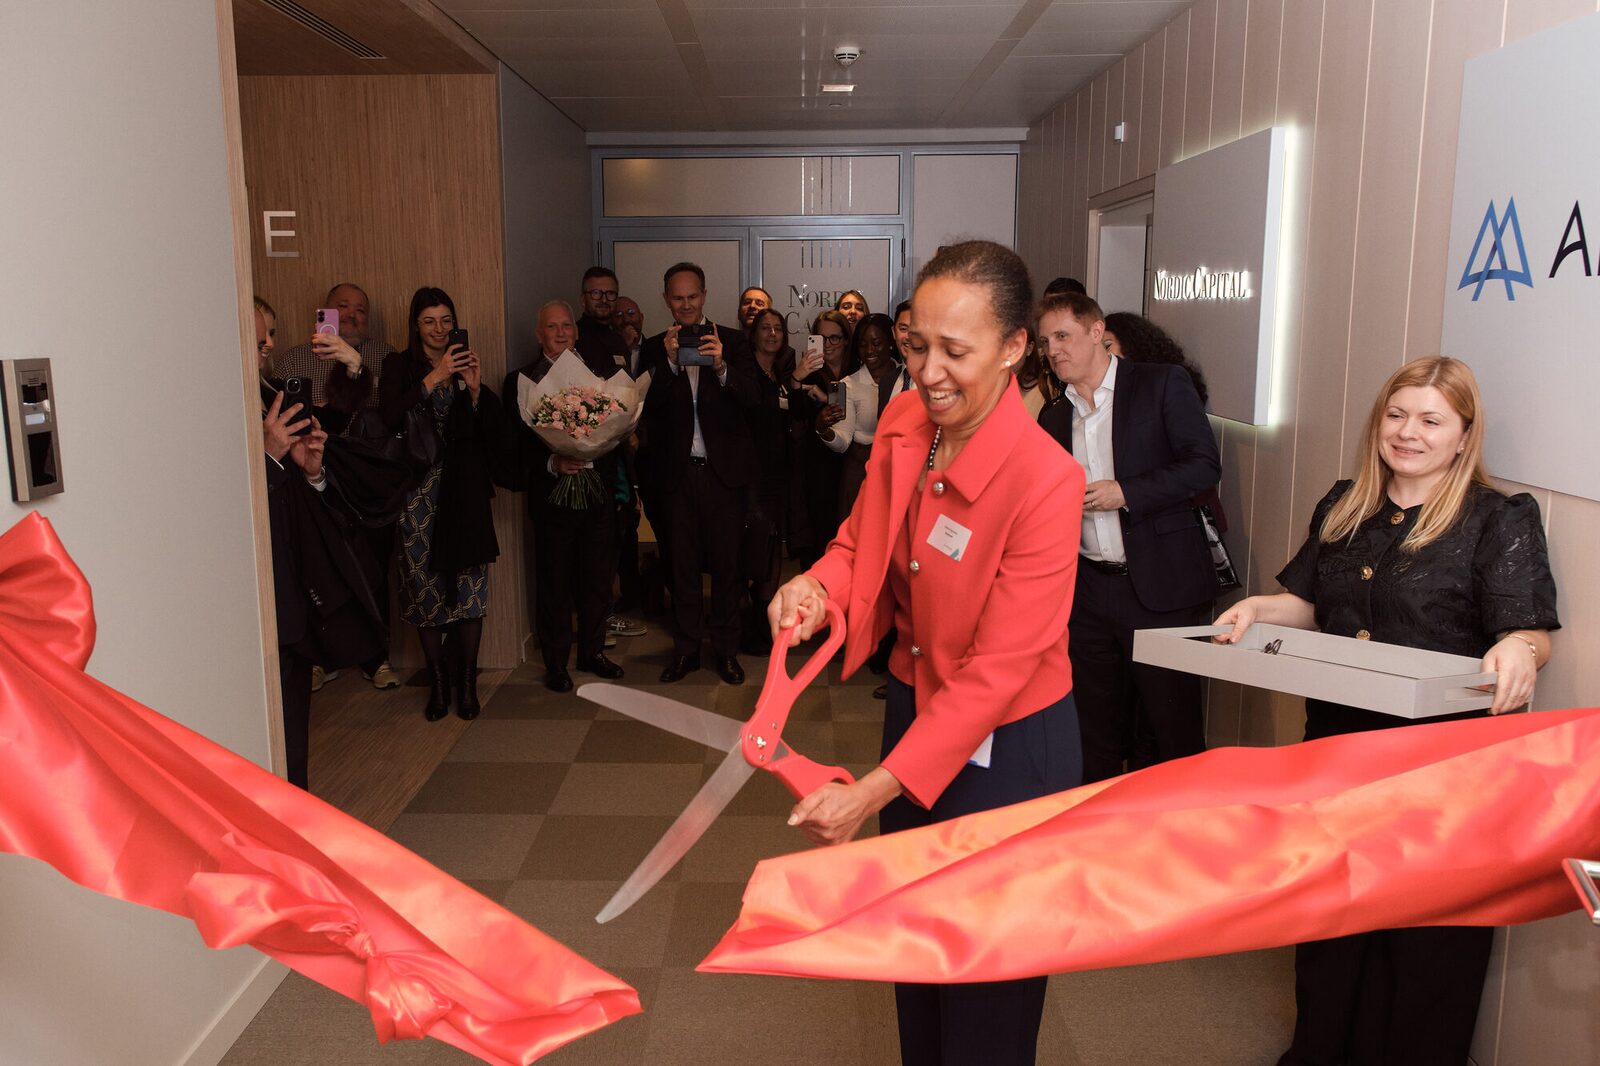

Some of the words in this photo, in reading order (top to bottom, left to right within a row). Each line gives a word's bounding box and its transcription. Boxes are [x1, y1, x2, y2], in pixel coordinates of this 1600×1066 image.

[263, 210, 300, 258] E
[1548, 199, 1600, 279] A
[1153, 270, 1192, 300] NORDIC
[1192, 266, 1247, 300] CAPITAL
